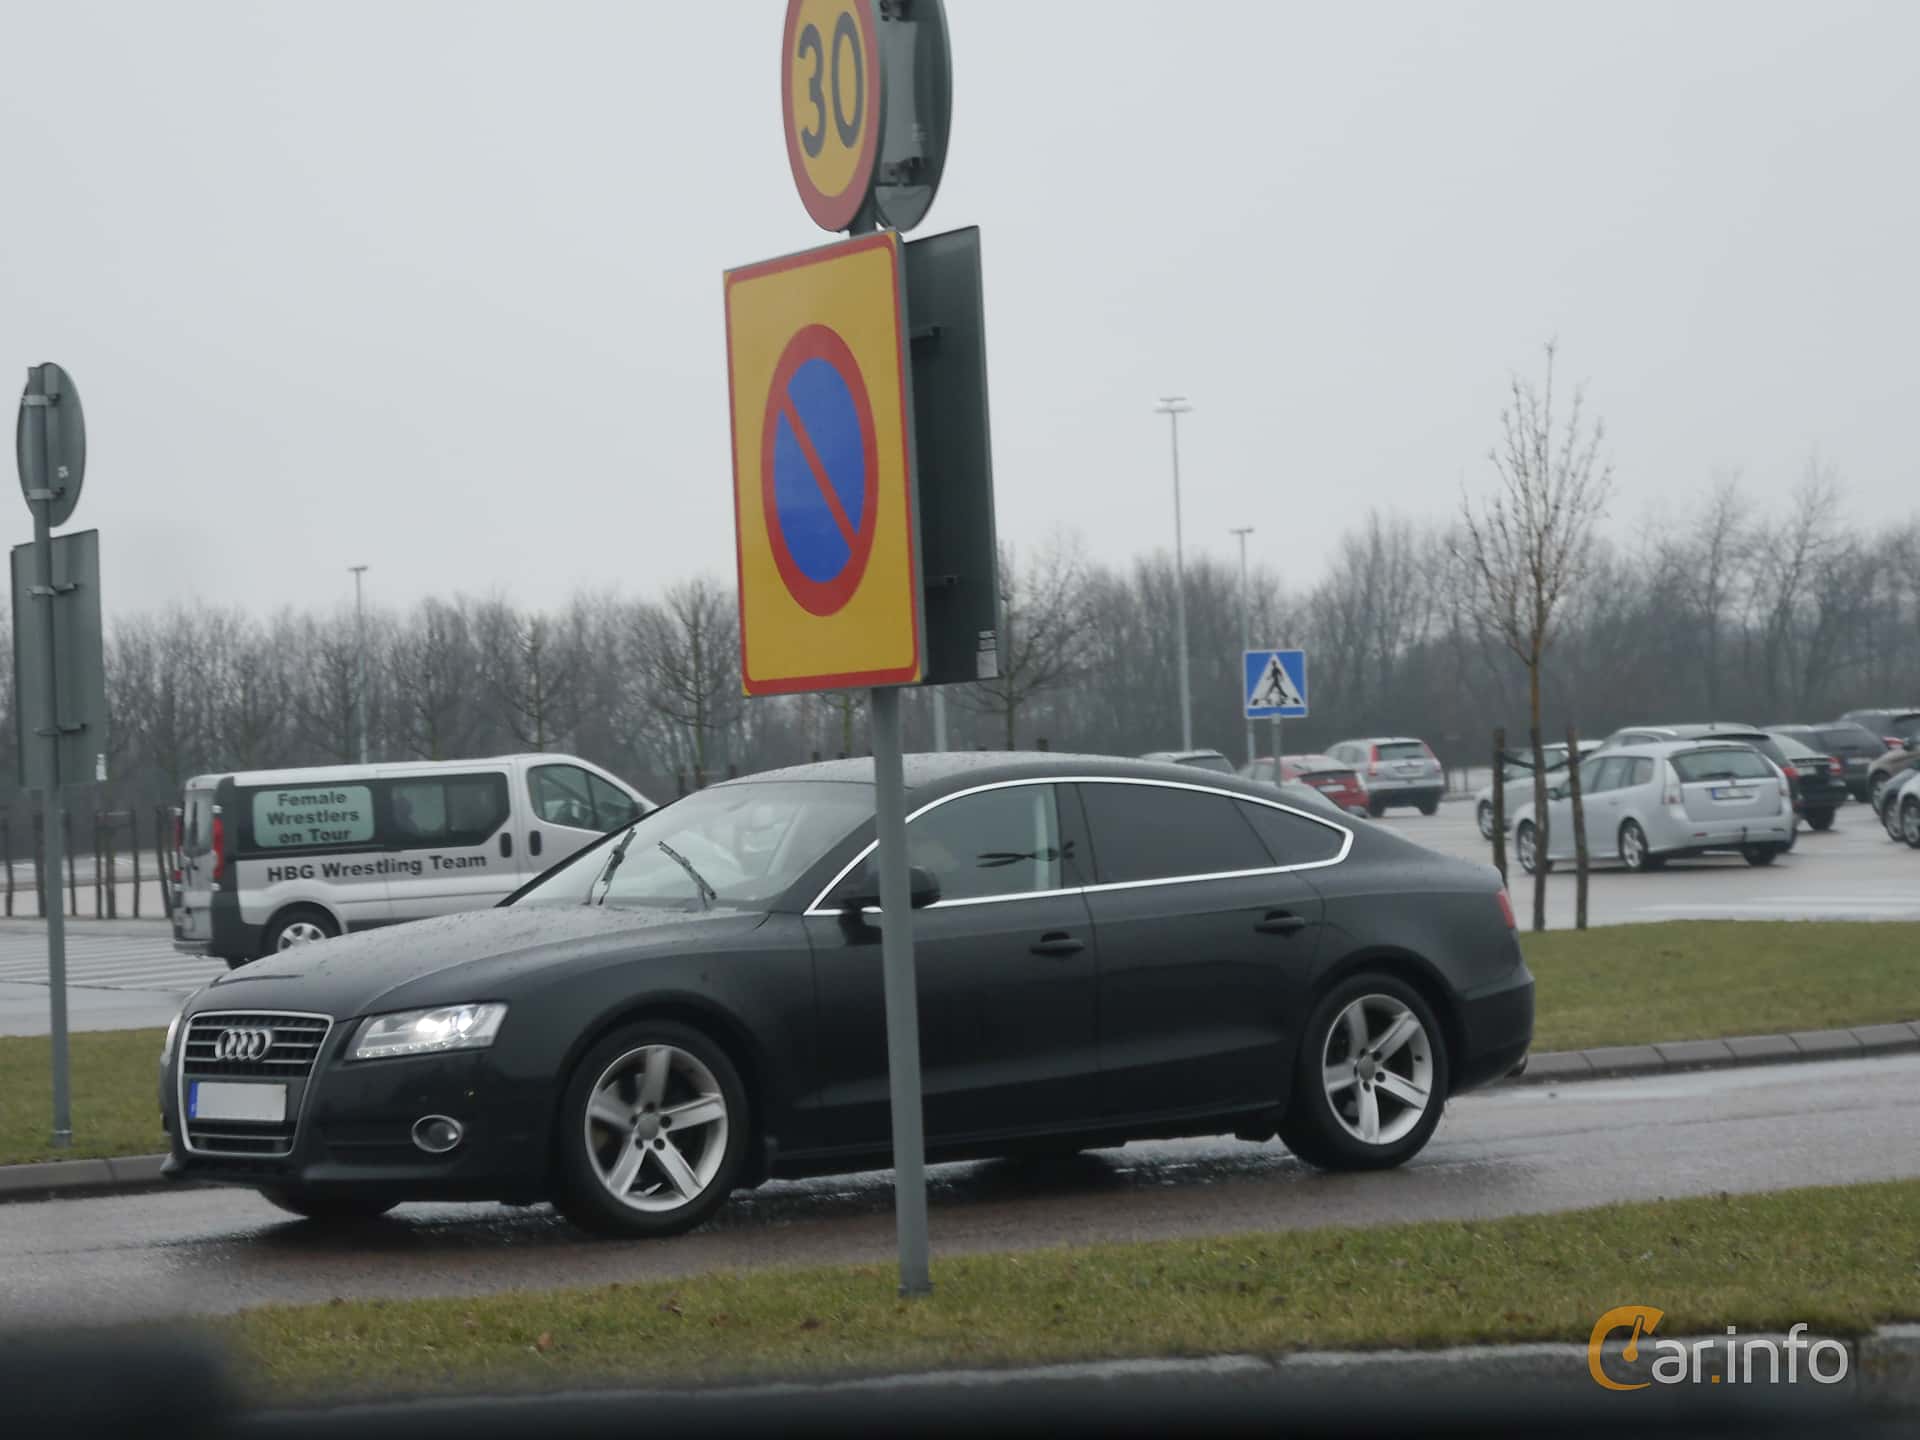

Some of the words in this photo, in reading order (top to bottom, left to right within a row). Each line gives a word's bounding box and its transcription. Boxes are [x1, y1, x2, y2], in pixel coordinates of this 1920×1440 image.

[798, 11, 864, 158] 30
[277, 791, 347, 807] Female
[266, 809, 360, 826] Wrestlers
[278, 832, 303, 844] on
[307, 828, 351, 842] Tour
[267, 864, 315, 882] HBG
[321, 858, 422, 877] Wrestling
[428, 855, 488, 870] Team
